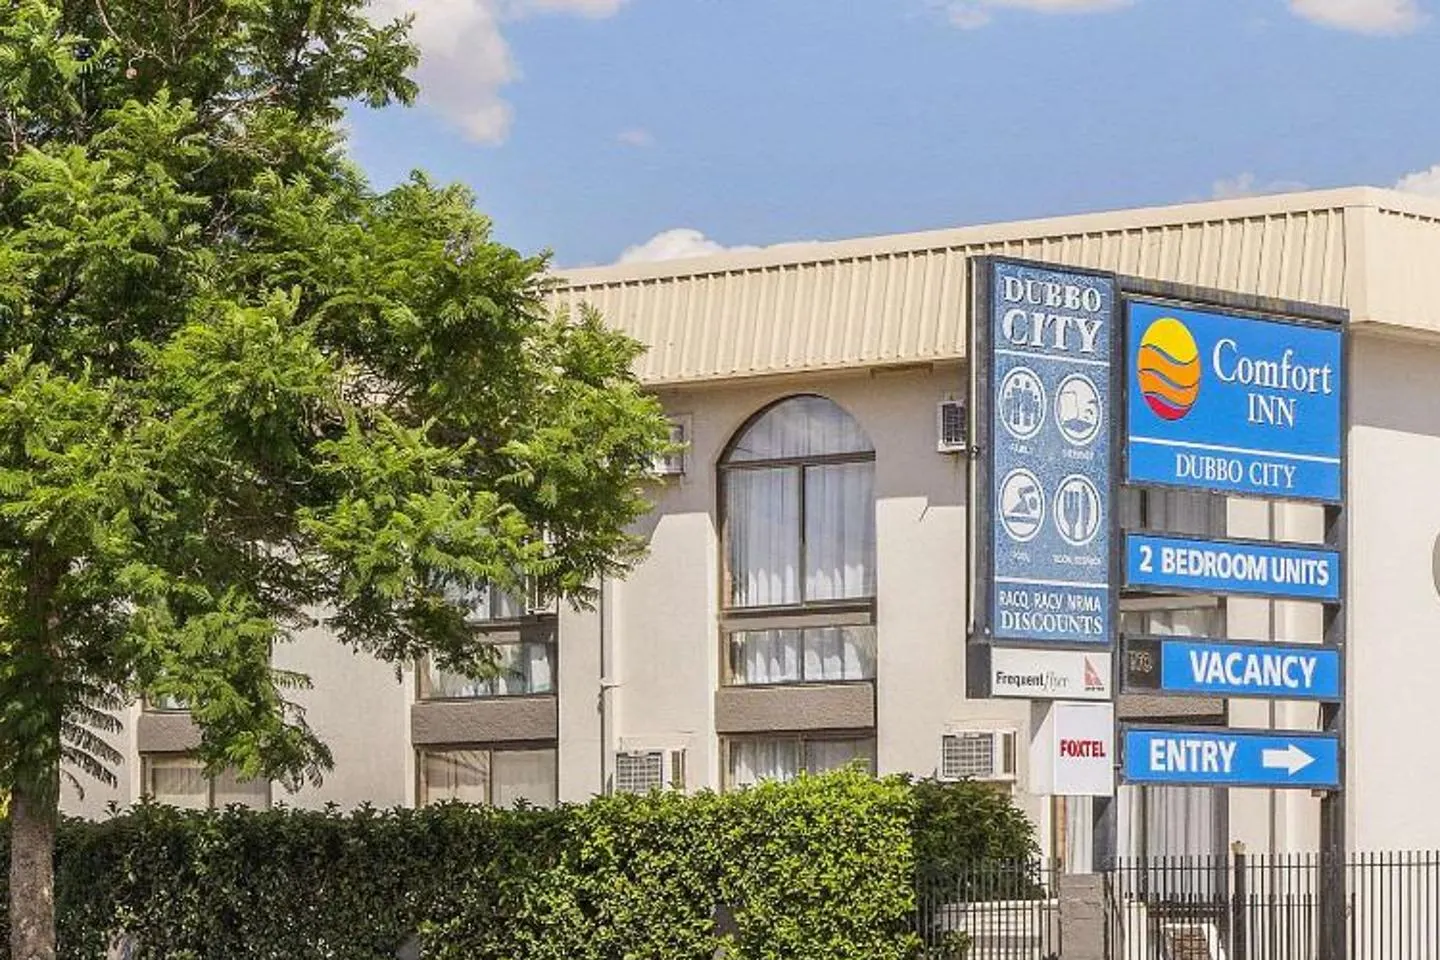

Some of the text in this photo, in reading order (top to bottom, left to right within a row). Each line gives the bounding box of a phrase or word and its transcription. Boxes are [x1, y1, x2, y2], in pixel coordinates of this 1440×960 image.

[1003, 276, 1101, 312] DUBBO
[1002, 308, 1103, 352] CITY
[1212, 339, 1332, 394] Comfort
[1247, 393, 1296, 427] INN
[1175, 453, 1296, 488] DUBBO CITY
[1139, 546, 1330, 586] 2 BEDROOM UNITS
[1000, 610, 1103, 635] DISCOUNTS
[1190, 650, 1317, 688] VACANCY
[1060, 739, 1106, 758] FOXTEL
[1150, 739, 1237, 773] ENTRY
